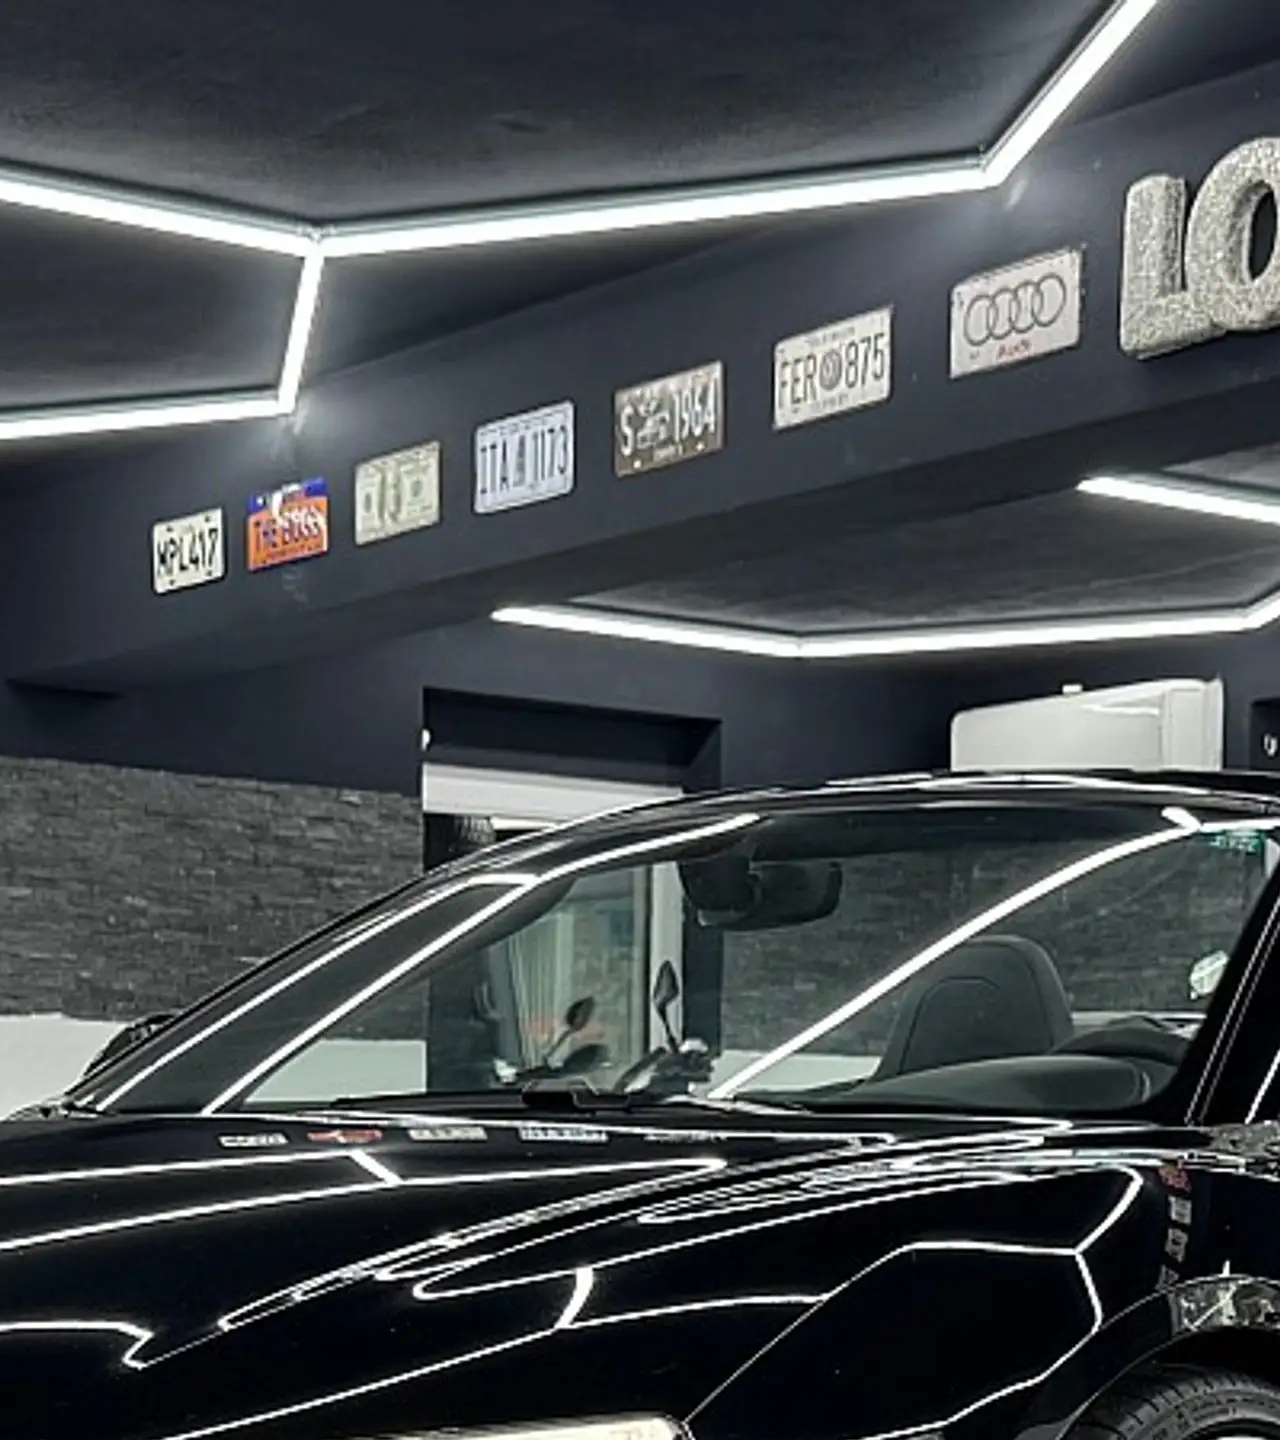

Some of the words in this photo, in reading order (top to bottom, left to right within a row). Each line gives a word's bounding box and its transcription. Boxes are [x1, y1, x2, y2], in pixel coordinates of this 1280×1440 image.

[779, 353, 818, 411] FER
[845, 331, 887, 389] 875
[620, 403, 637, 458] S
[478, 440, 511, 495] ITA
